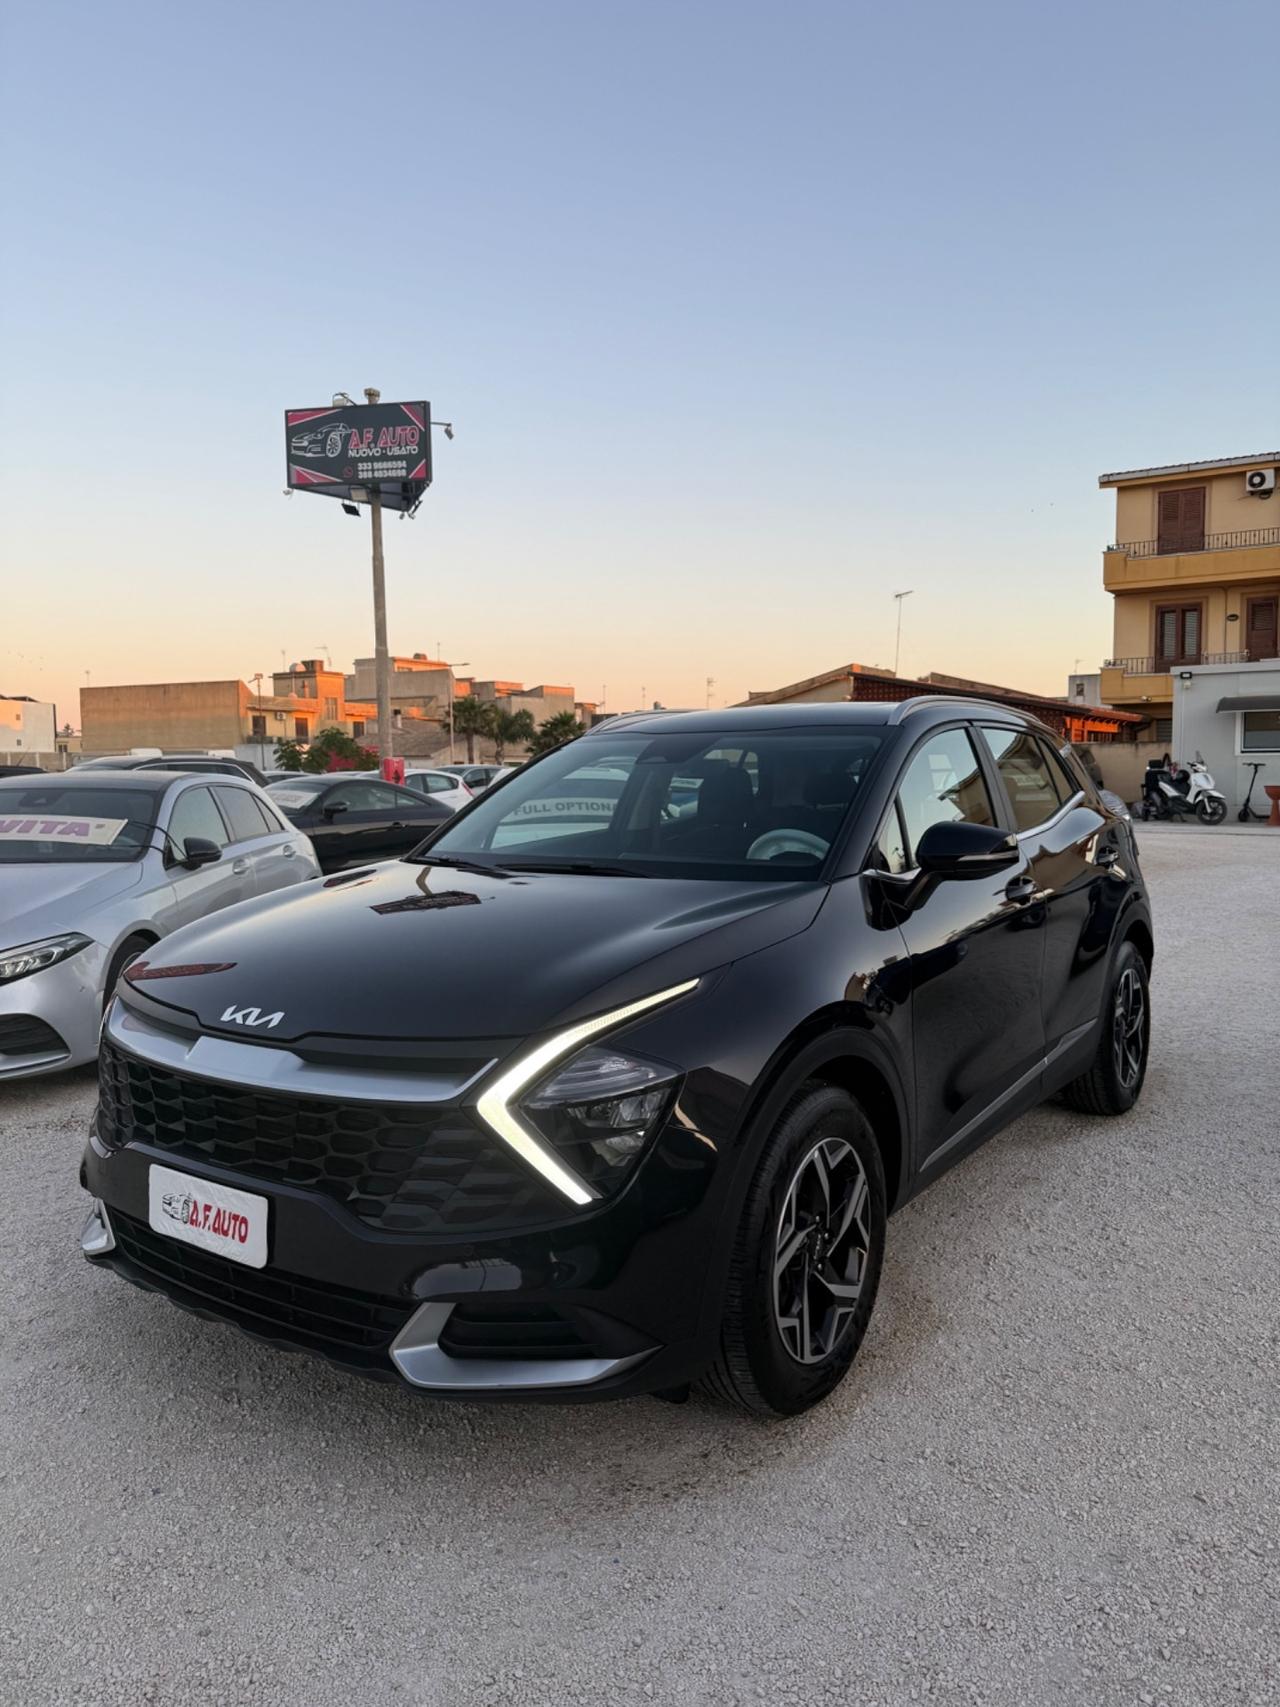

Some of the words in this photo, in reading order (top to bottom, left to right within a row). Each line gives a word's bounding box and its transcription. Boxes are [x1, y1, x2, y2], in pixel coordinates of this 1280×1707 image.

[377, 425, 420, 447] AUTO
[348, 447, 381, 458] NUOVO
[386, 445, 419, 456] USATO
[357, 462, 372, 471] 333
[212, 1207, 249, 1244] AUTO
